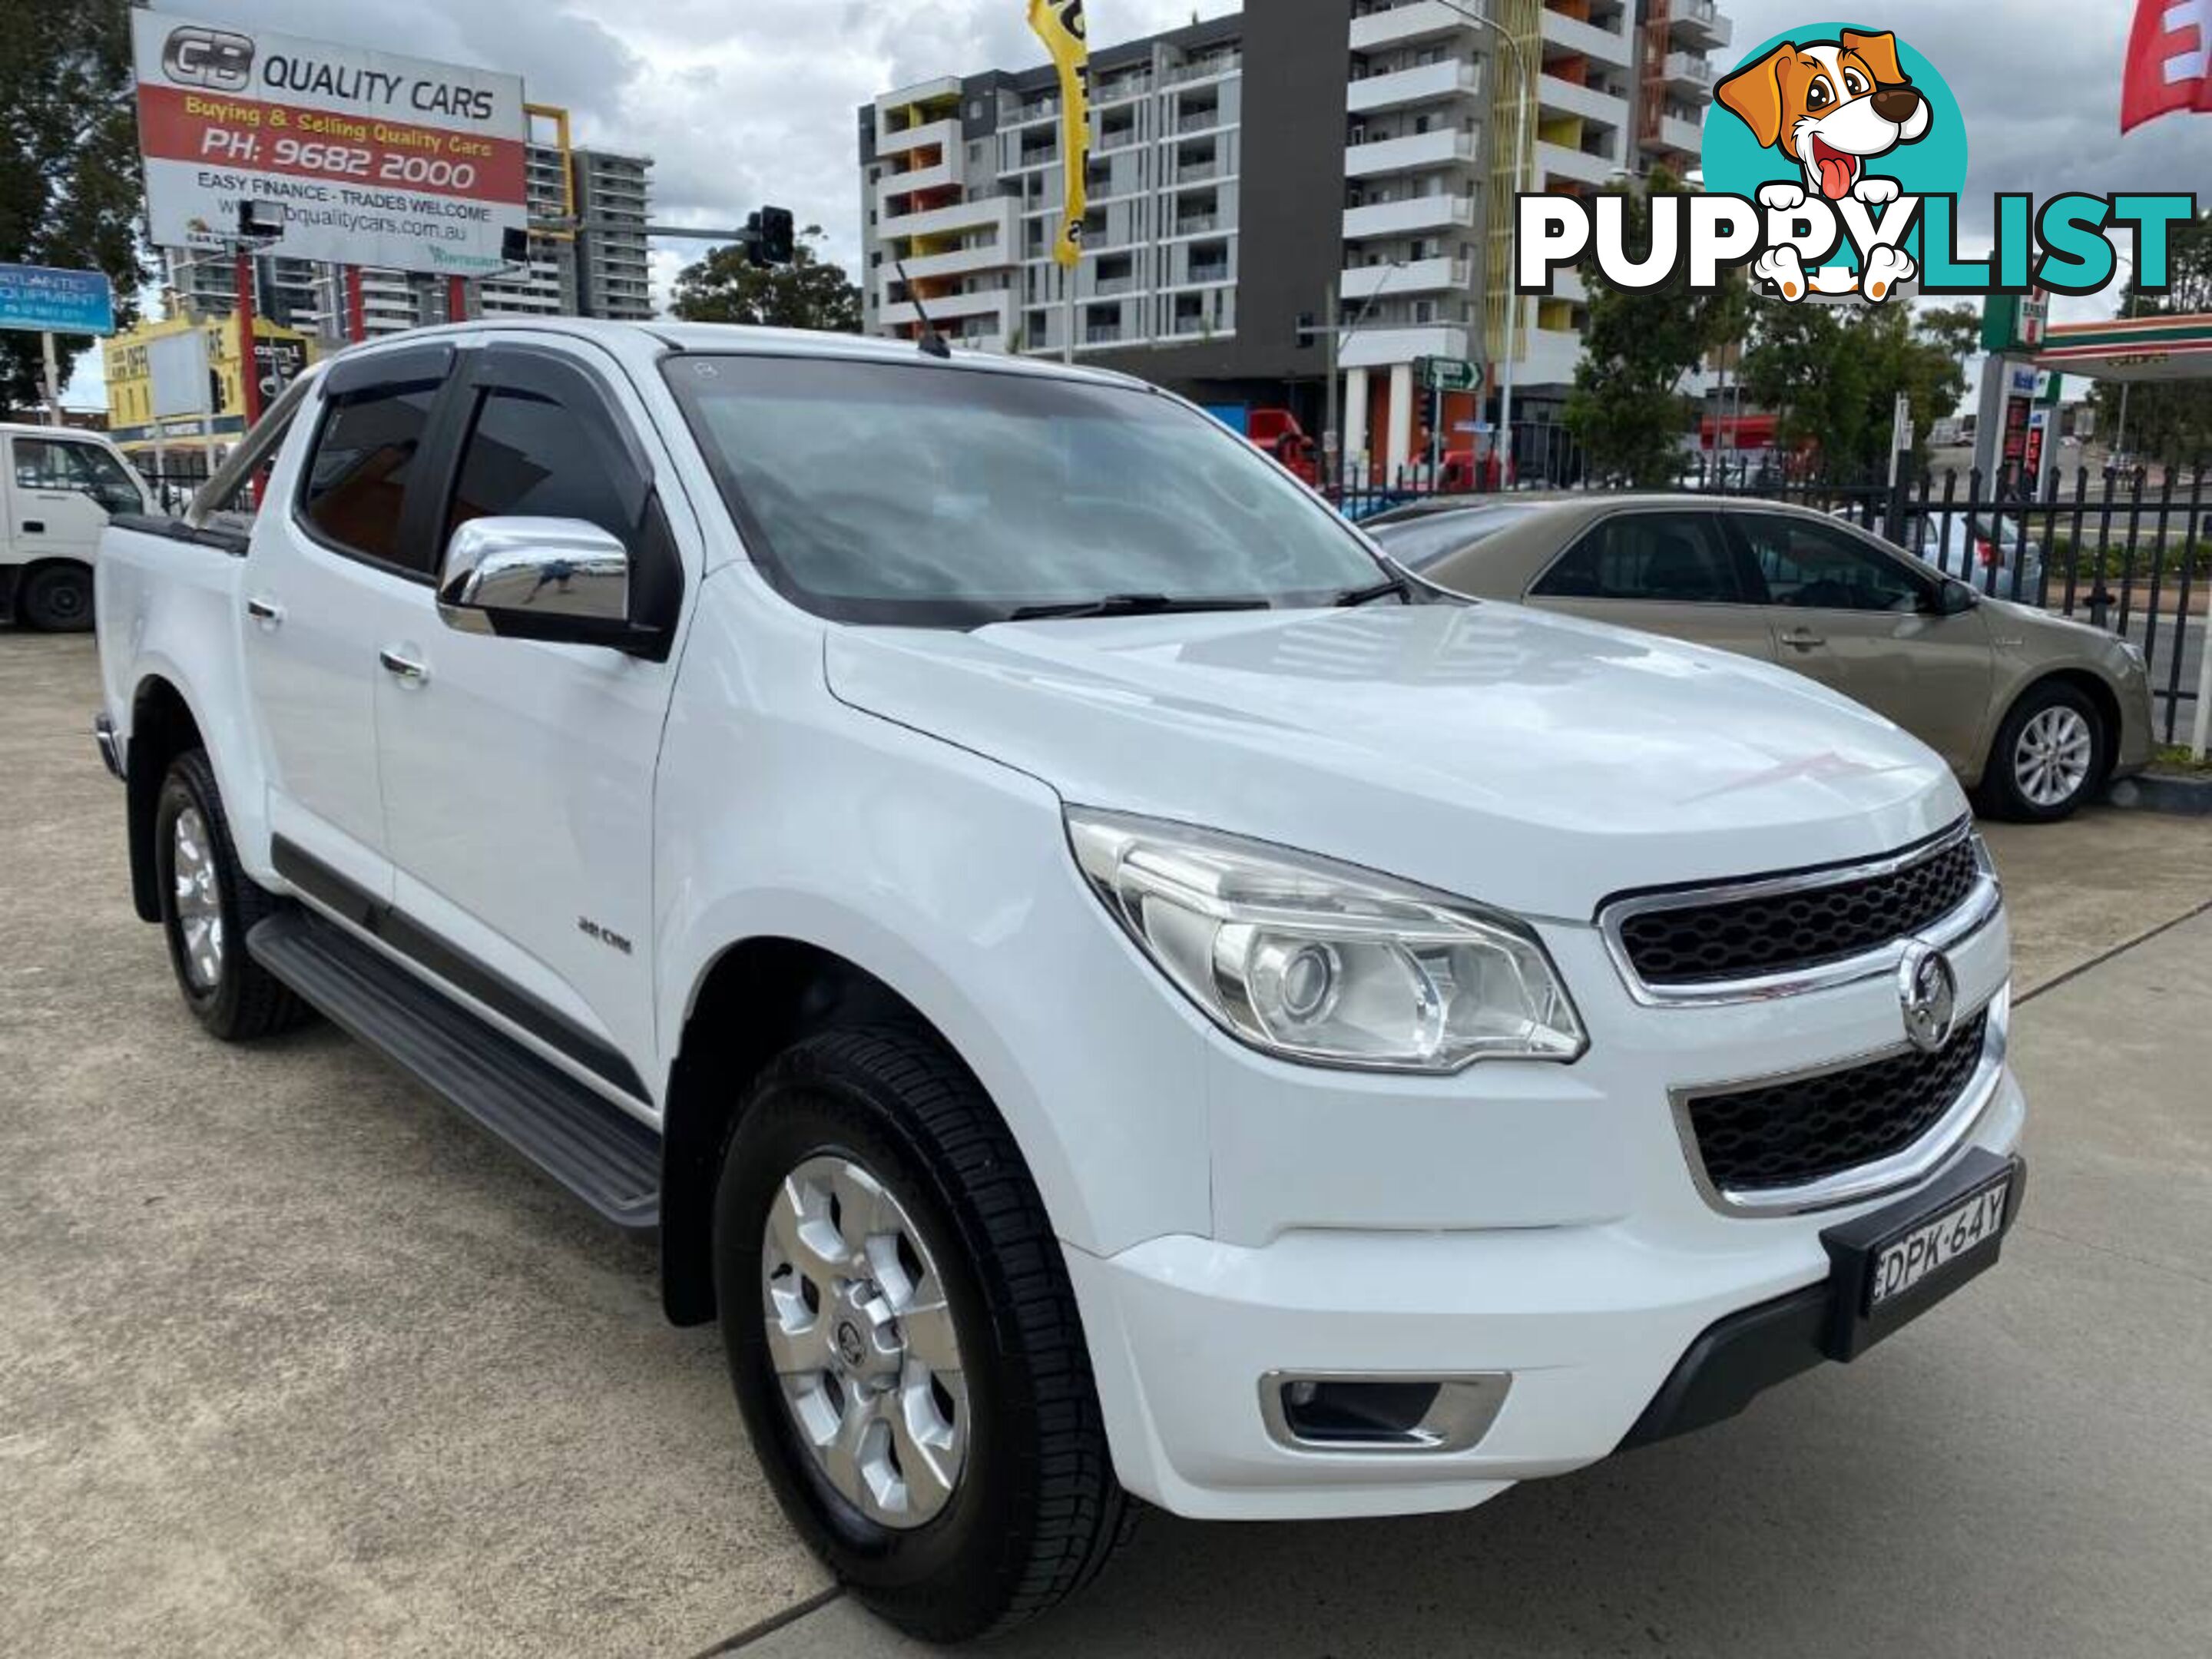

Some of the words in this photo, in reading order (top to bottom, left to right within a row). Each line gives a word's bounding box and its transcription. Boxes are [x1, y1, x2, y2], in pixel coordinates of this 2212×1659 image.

[263, 56, 402, 104] QUALITY
[411, 81, 493, 119] CARS
[185, 96, 260, 126] Buying
[269, 109, 288, 126] &
[297, 114, 366, 142] Selling
[373, 123, 442, 152] Quality
[449, 137, 492, 157] Cars
[201, 127, 263, 161] PH:
[273, 139, 372, 176] 9682
[379, 153, 475, 189] 2000
[198, 171, 247, 190] EASY
[252, 178, 329, 202] FINANCE
[340, 189, 407, 211] TRADES
[409, 198, 493, 223] WELCOME
